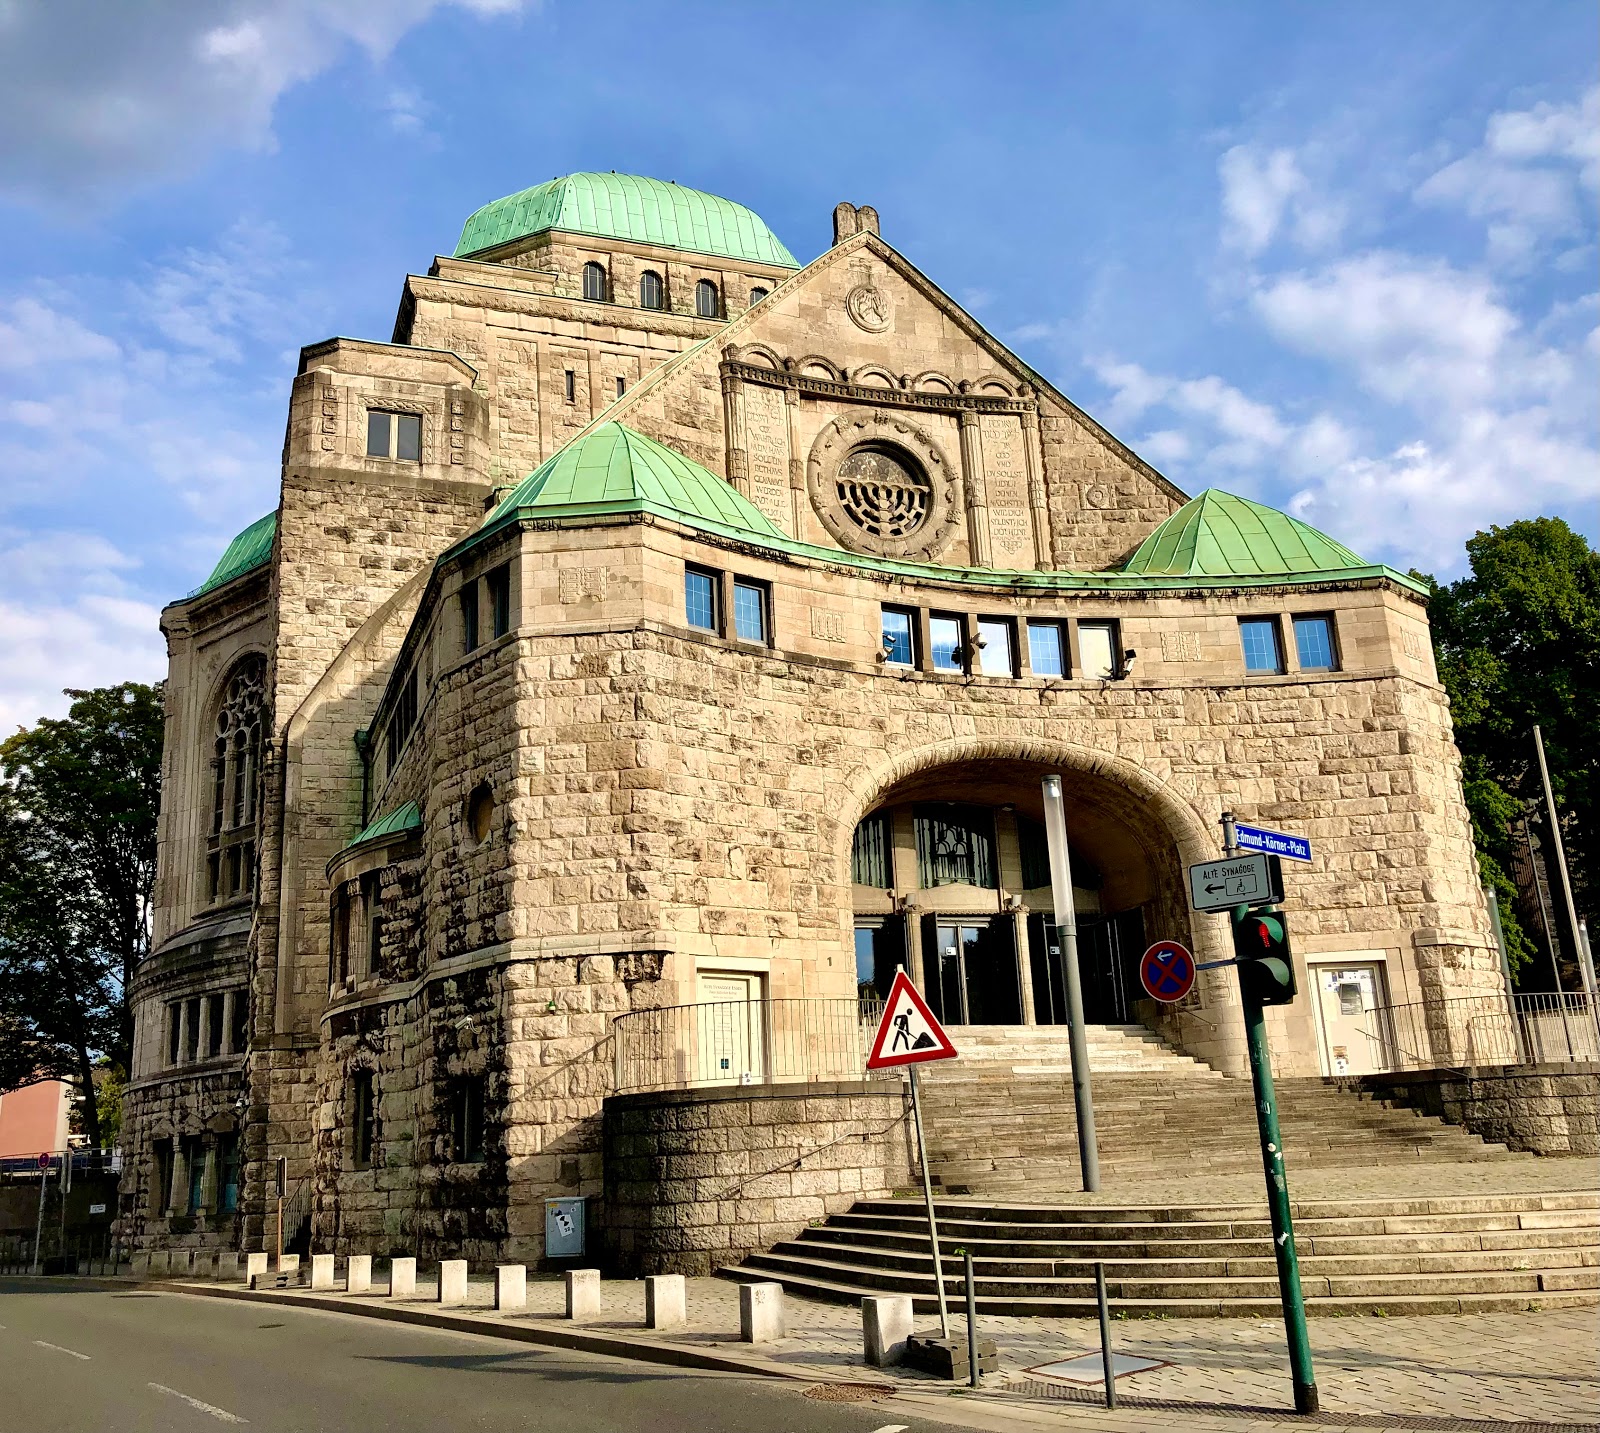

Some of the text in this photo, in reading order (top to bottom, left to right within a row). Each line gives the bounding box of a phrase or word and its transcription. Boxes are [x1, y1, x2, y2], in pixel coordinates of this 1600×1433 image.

[1236, 829, 1306, 855] Edmund-Körner-Platz
[1203, 864, 1255, 880] ALTE SYNAGOGE
[827, 956, 832, 967] 1
